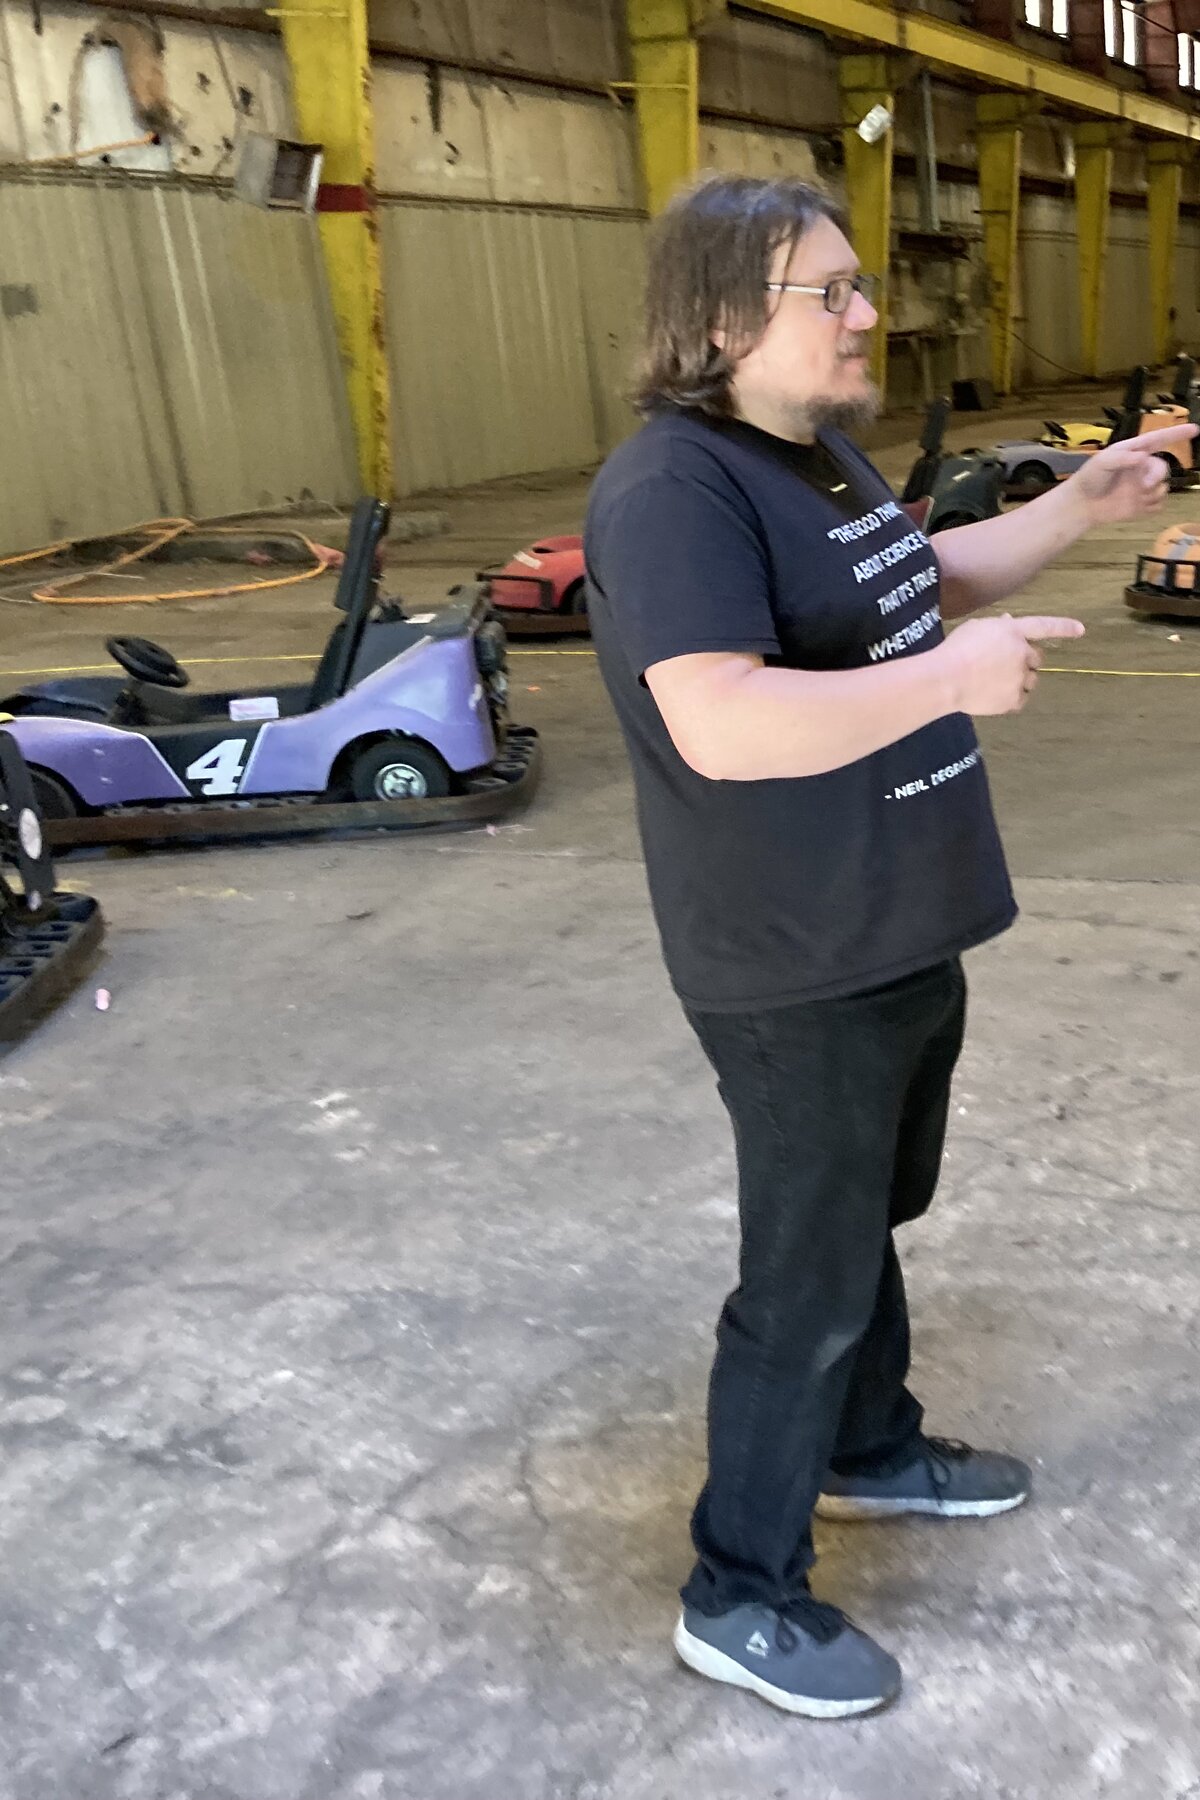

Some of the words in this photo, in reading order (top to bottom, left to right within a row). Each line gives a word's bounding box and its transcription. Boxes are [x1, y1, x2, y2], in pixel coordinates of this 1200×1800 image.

[849, 512, 882, 537] GOOD
[852, 554, 885, 583] ABOUT
[879, 533, 924, 567] SCIENCE
[910, 566, 938, 594] TRUE
[867, 619, 926, 661] WHETHER
[186, 738, 247, 796] 4
[894, 779, 929, 799] NEIL
